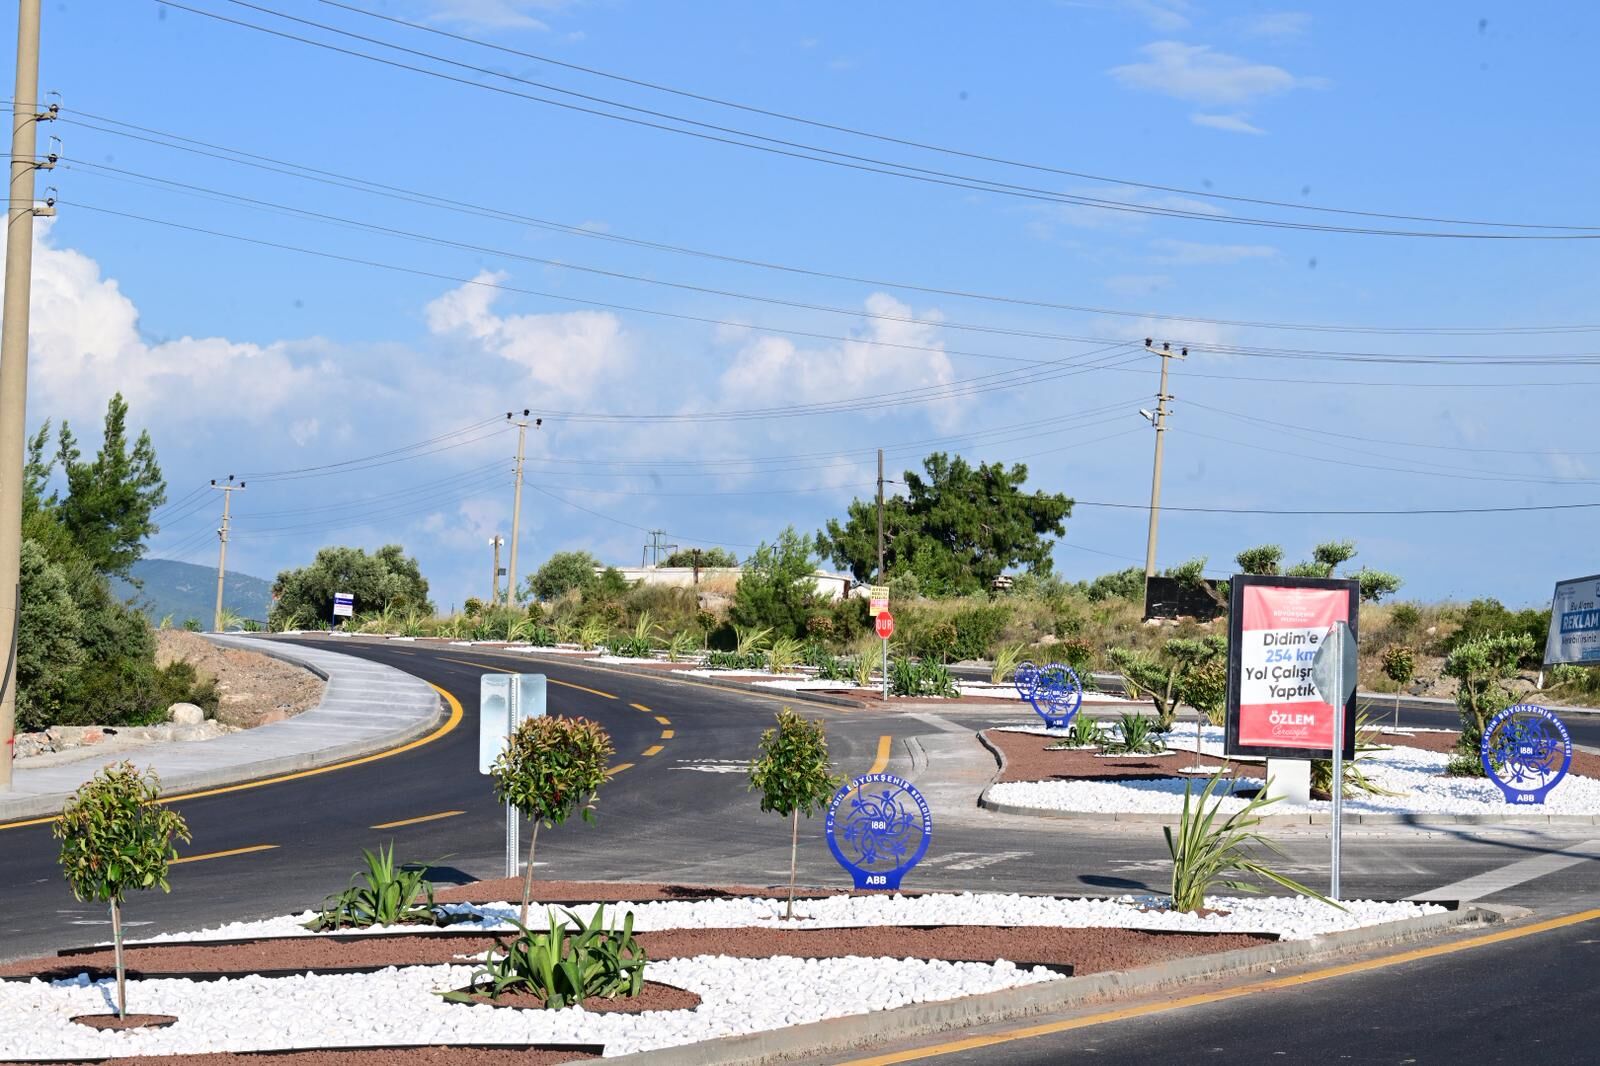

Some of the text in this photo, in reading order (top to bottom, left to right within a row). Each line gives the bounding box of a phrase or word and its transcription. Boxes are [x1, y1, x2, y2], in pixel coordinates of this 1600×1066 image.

[876, 619, 892, 630] DUR
[1563, 613, 1599, 630] REKLAM
[1263, 631, 1319, 646] Didim'e
[1265, 649, 1316, 662] 254 km
[1246, 664, 1268, 680] Yol
[1269, 683, 1316, 700] Yaptık
[1269, 711, 1315, 726] ÖZLEM
[1517, 794, 1535, 802] ABB
[911, 790, 932, 835] BELEDİYESİ
[872, 821, 886, 829] 1881
[866, 876, 887, 885] ABB
